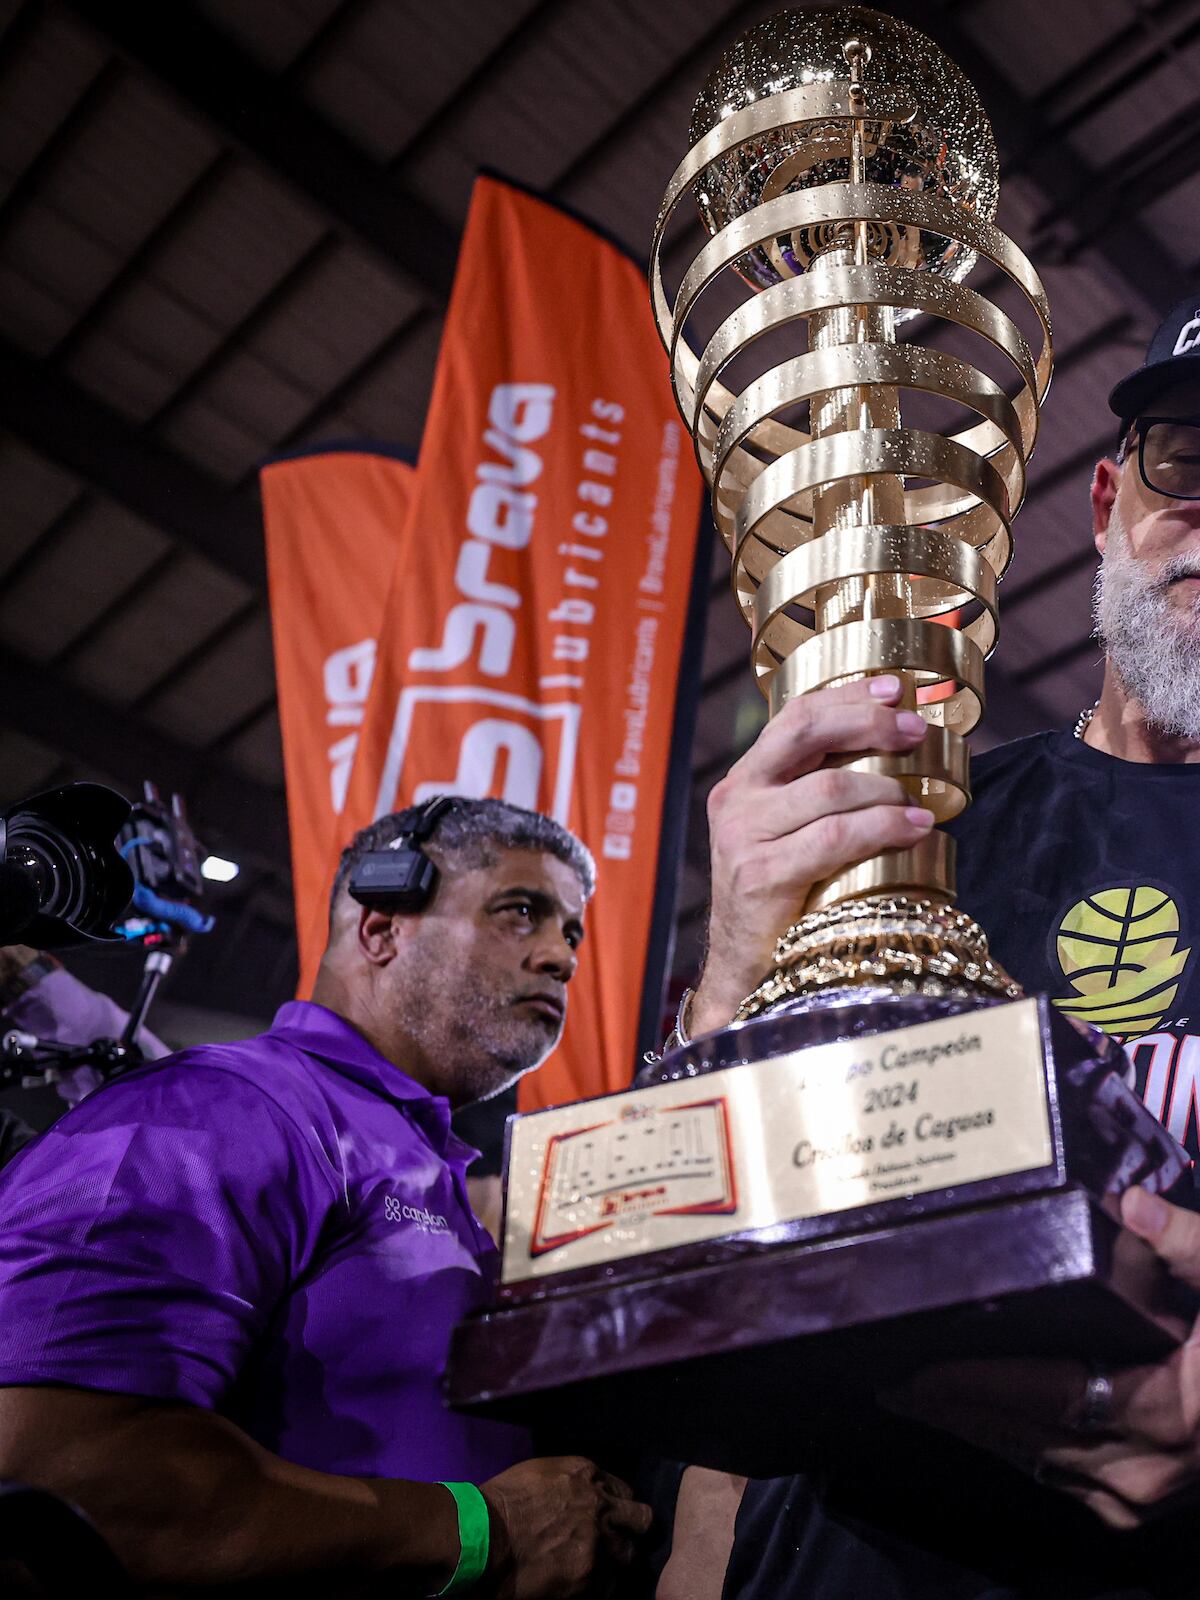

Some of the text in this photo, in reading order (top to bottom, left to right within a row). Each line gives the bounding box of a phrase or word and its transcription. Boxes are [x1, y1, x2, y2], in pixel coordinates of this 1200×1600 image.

[407, 382, 557, 678] brava
[538, 397, 626, 690] lubricants
[880, 1033, 982, 1072] Campeón
[864, 1080, 919, 1115] 2024
[880, 1120, 907, 1149] de
[914, 1109, 995, 1141] Caguas
